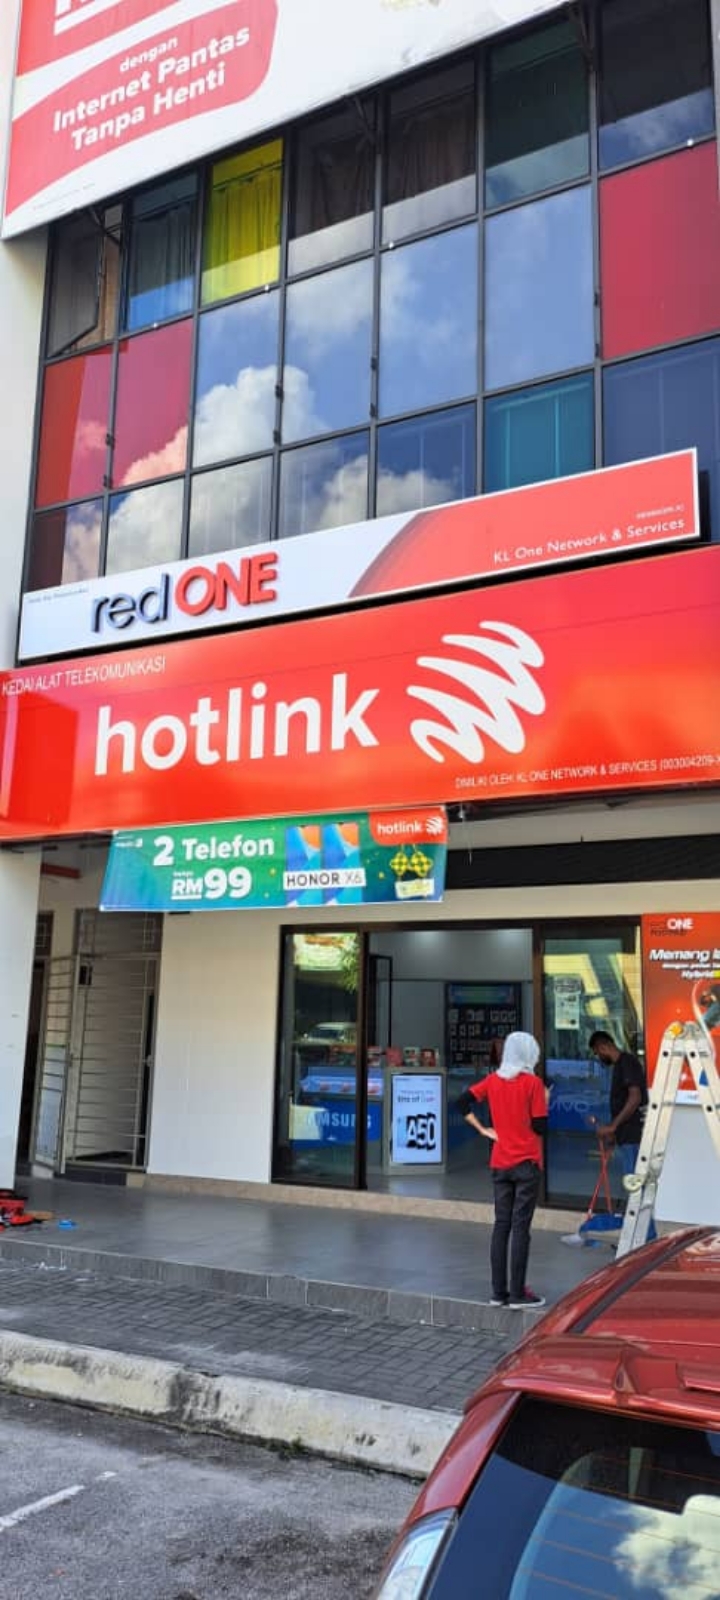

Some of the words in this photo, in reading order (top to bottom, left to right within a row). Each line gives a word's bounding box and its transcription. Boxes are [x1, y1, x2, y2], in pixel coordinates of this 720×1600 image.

[119, 37, 178, 72] dengan
[53, 71, 151, 132] Internet
[157, 27, 250, 84] Pantas
[71, 105, 145, 150] Tanpa
[153, 62, 226, 116] Henti
[493, 549, 510, 563] KL
[515, 546, 543, 559] One
[547, 535, 607, 553] Network
[611, 528, 622, 541] &
[627, 518, 685, 538] Services
[2, 678, 34, 696] KEDAI
[36, 672, 63, 690] ALAT
[65, 655, 166, 687] TELEKOMUNIKASI
[95, 672, 379, 776] hotlink
[529, 769, 551, 782] ONE
[551, 762, 598, 780] NETWORK
[600, 763, 607, 775] &
[609, 758, 657, 775] SERVICES
[377, 820, 422, 835] hotlink
[153, 835, 174, 866] 2
[182, 834, 275, 861] Telefon
[286, 872, 340, 887] HONOR
[345, 871, 363, 885] X6
[649, 949, 710, 963] Memang
